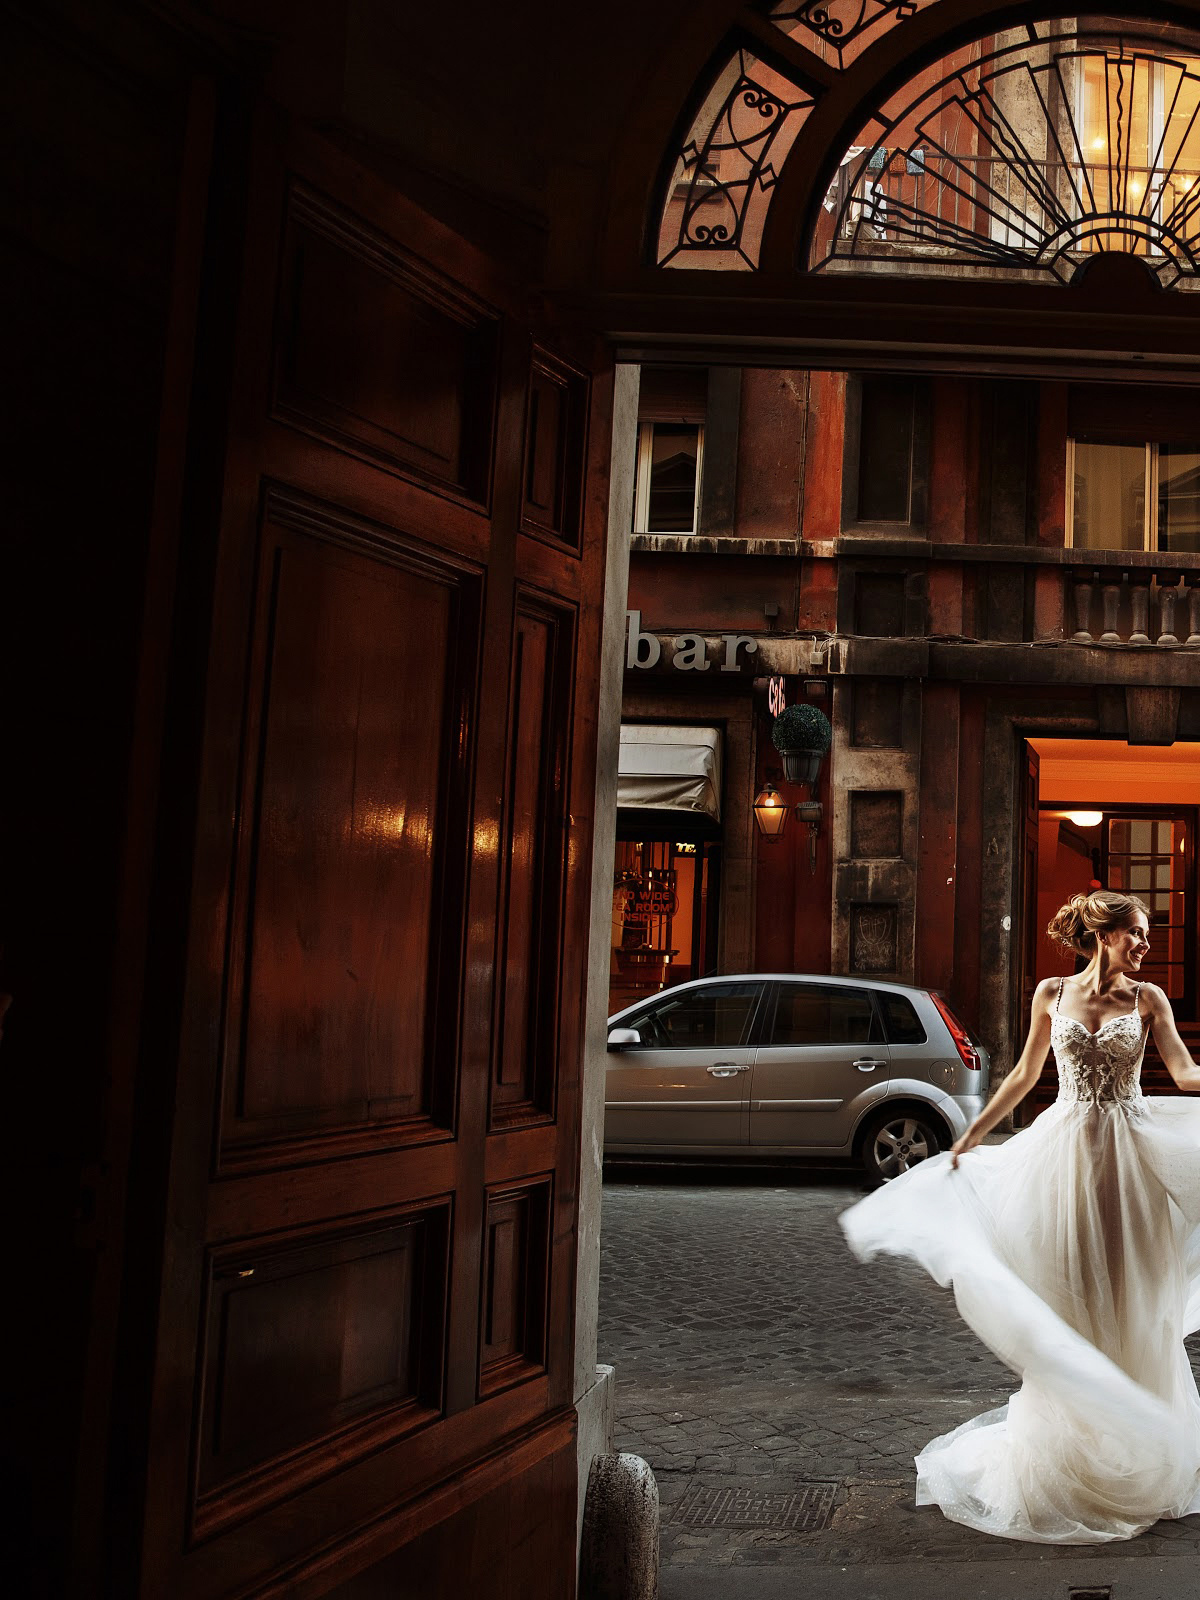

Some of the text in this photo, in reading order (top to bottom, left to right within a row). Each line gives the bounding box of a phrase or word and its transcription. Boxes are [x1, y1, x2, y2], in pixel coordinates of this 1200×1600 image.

[626, 610, 758, 672] bar
[639, 891, 670, 901] WIDE
[621, 912, 659, 922] INSIDE
